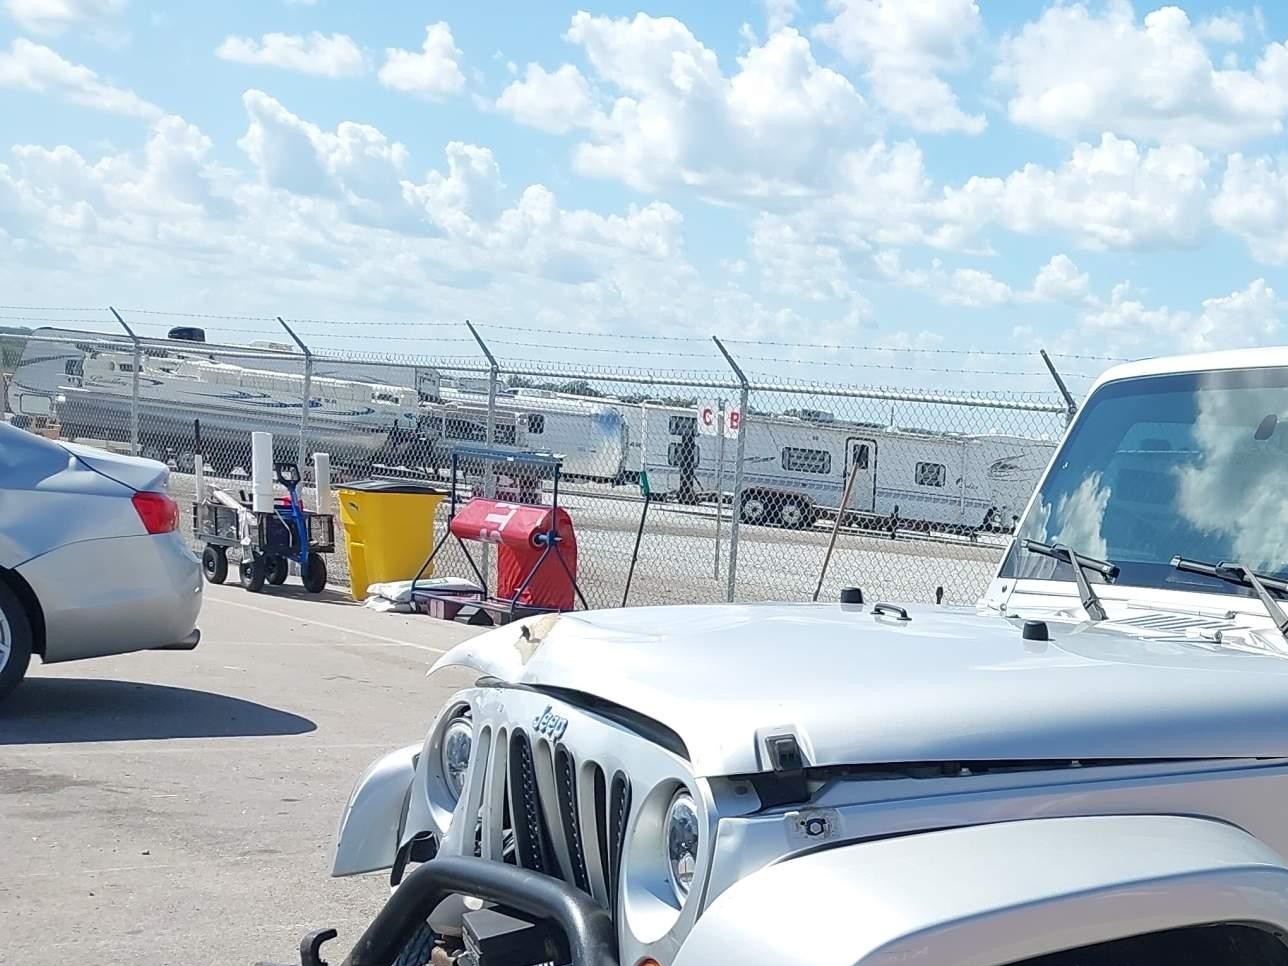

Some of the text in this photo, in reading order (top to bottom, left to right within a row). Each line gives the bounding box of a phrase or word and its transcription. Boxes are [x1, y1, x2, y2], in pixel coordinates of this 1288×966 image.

[702, 408, 713, 427] C
[729, 411, 741, 430] B
[532, 703, 569, 746] Jeep
